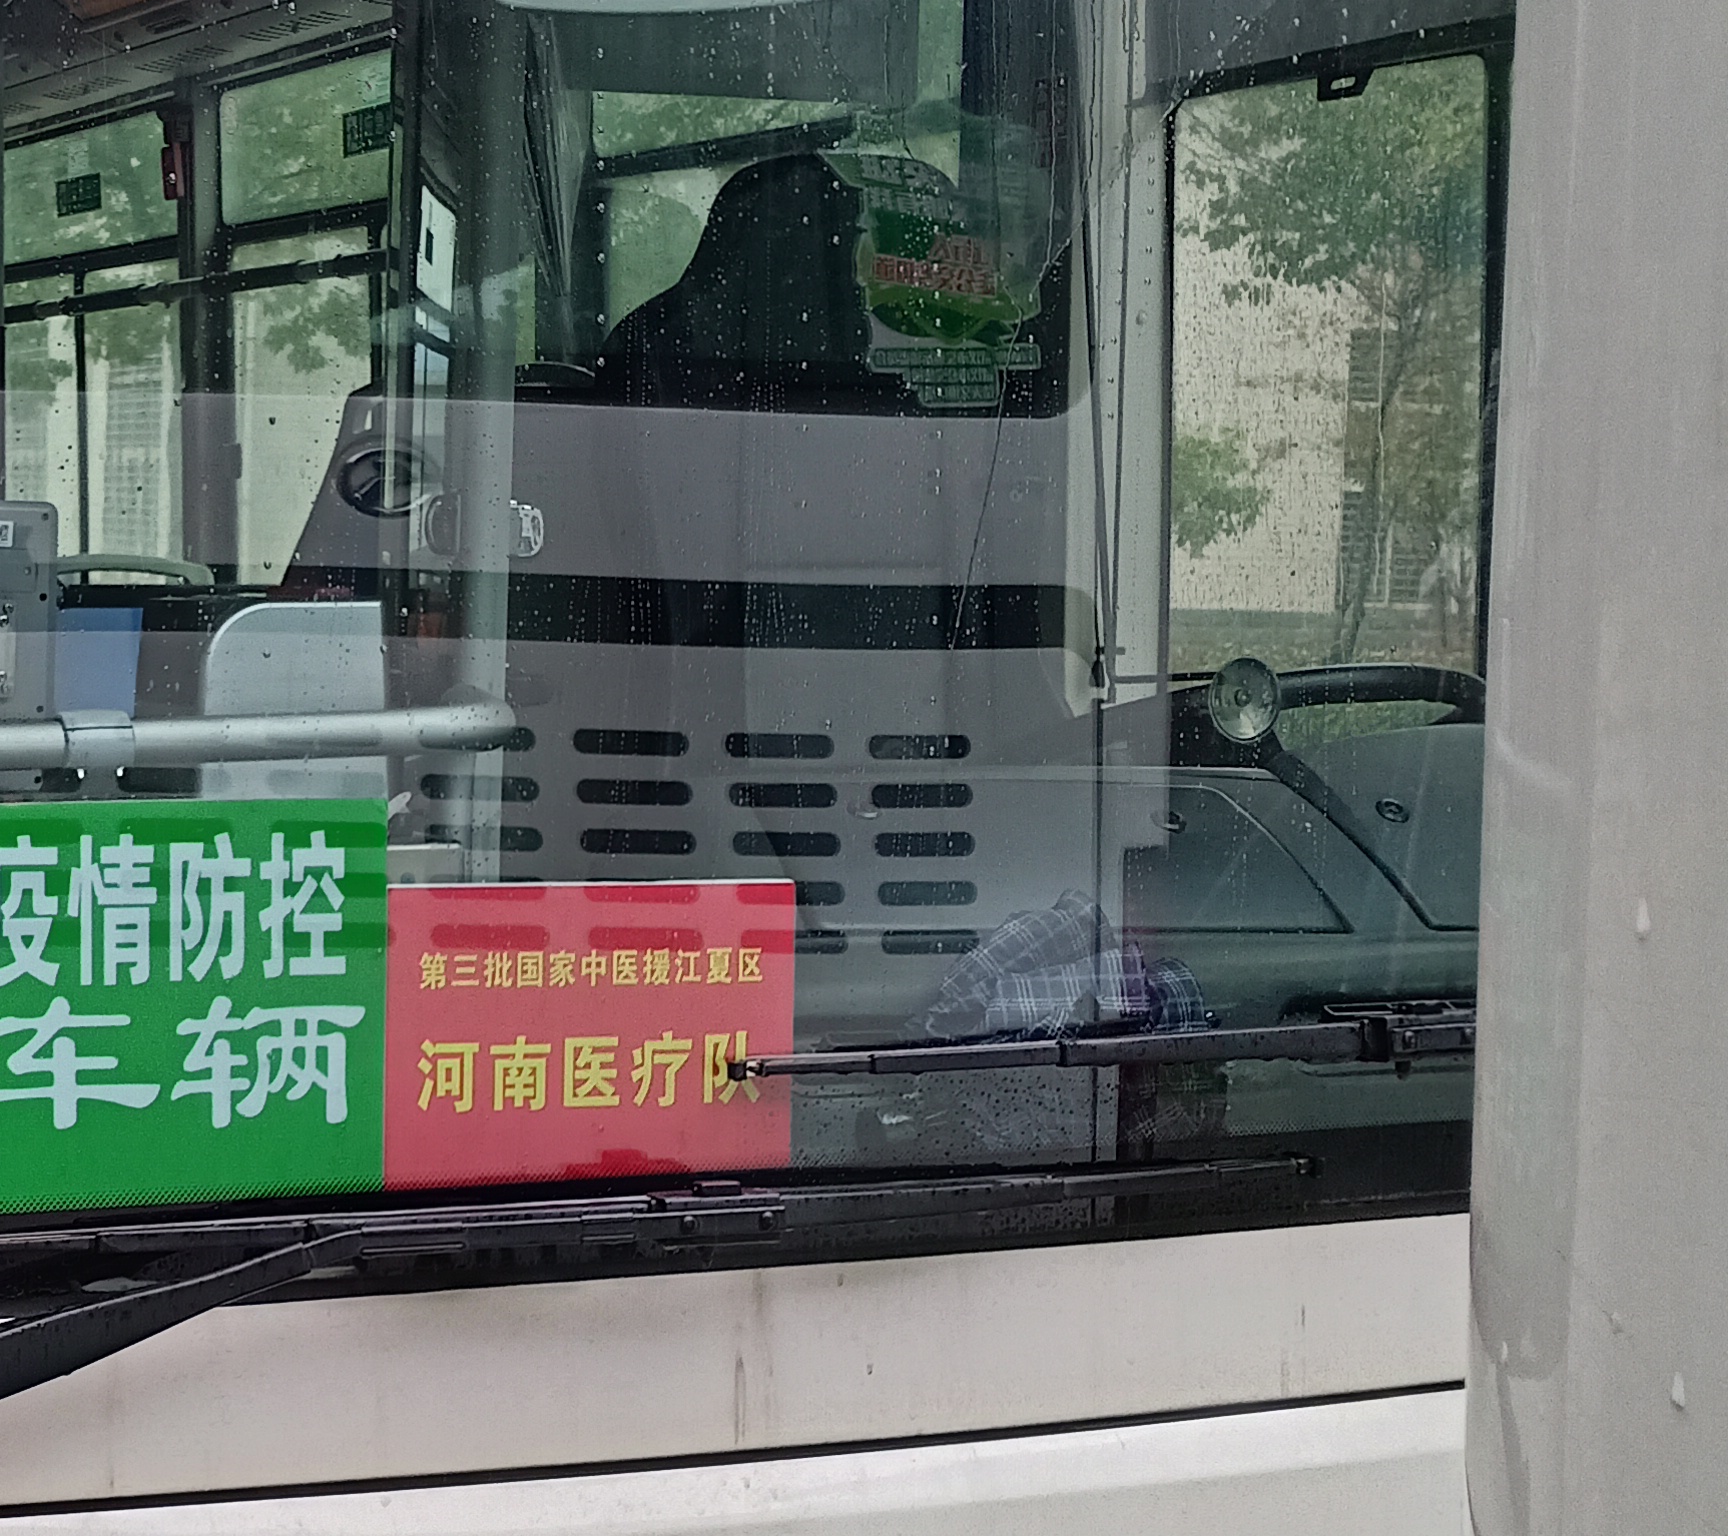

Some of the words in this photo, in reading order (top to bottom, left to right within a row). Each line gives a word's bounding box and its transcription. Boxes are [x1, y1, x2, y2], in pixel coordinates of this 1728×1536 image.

[419, 946, 764, 991] 第三批国家中医援江夏区
[417, 1030, 761, 1114] 河南医疗队
